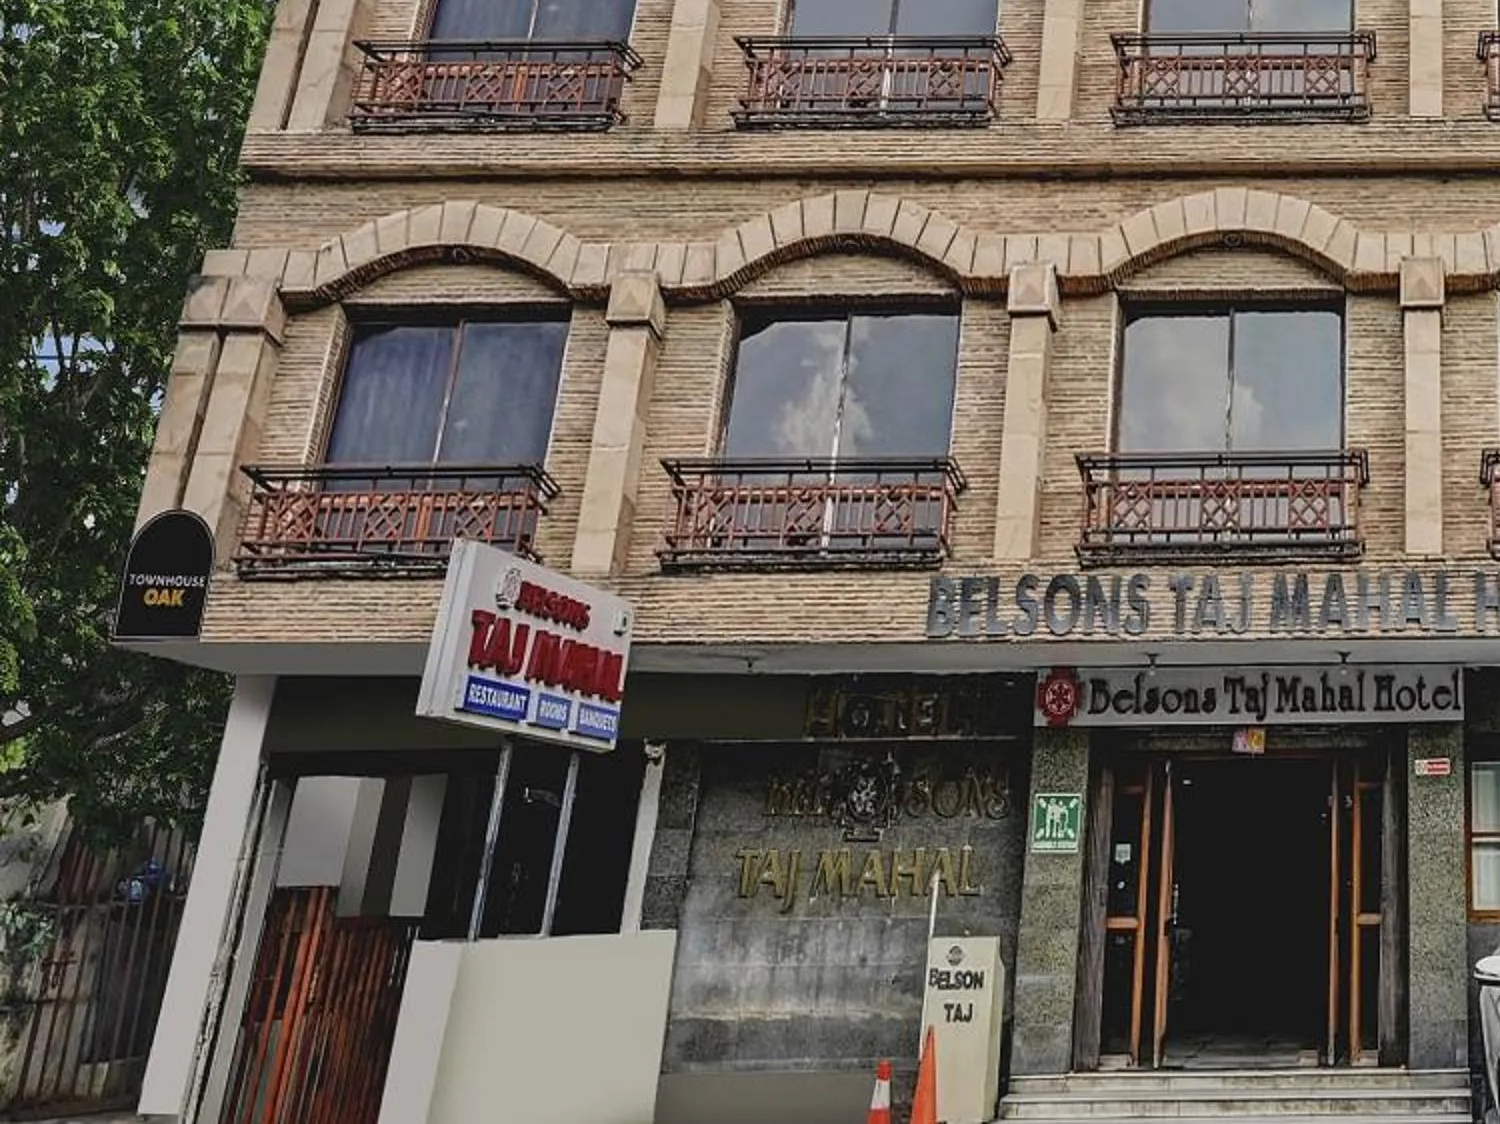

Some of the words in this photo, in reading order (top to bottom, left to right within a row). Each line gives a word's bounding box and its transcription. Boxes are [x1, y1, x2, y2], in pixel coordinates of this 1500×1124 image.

[129, 573, 206, 587] TOWNHOUSE
[143, 588, 186, 607] OAK
[926, 573, 1149, 637] BELSONS
[1170, 572, 1253, 634] TAJ
[1269, 571, 1457, 632] MAHAL
[468, 609, 530, 678] TAJ
[468, 683, 527, 713] RESTAURANT
[1087, 673, 1216, 715] Belsons
[1223, 673, 1271, 721] Taj
[1275, 671, 1364, 713] Mahal
[1373, 668, 1461, 712] Hotel
[539, 699, 568, 722] ROOMS
[736, 848, 802, 913] TAJ
[809, 845, 982, 900] MAHAL
[928, 967, 985, 991] BELSON
[944, 1002, 974, 1023] TAJ
